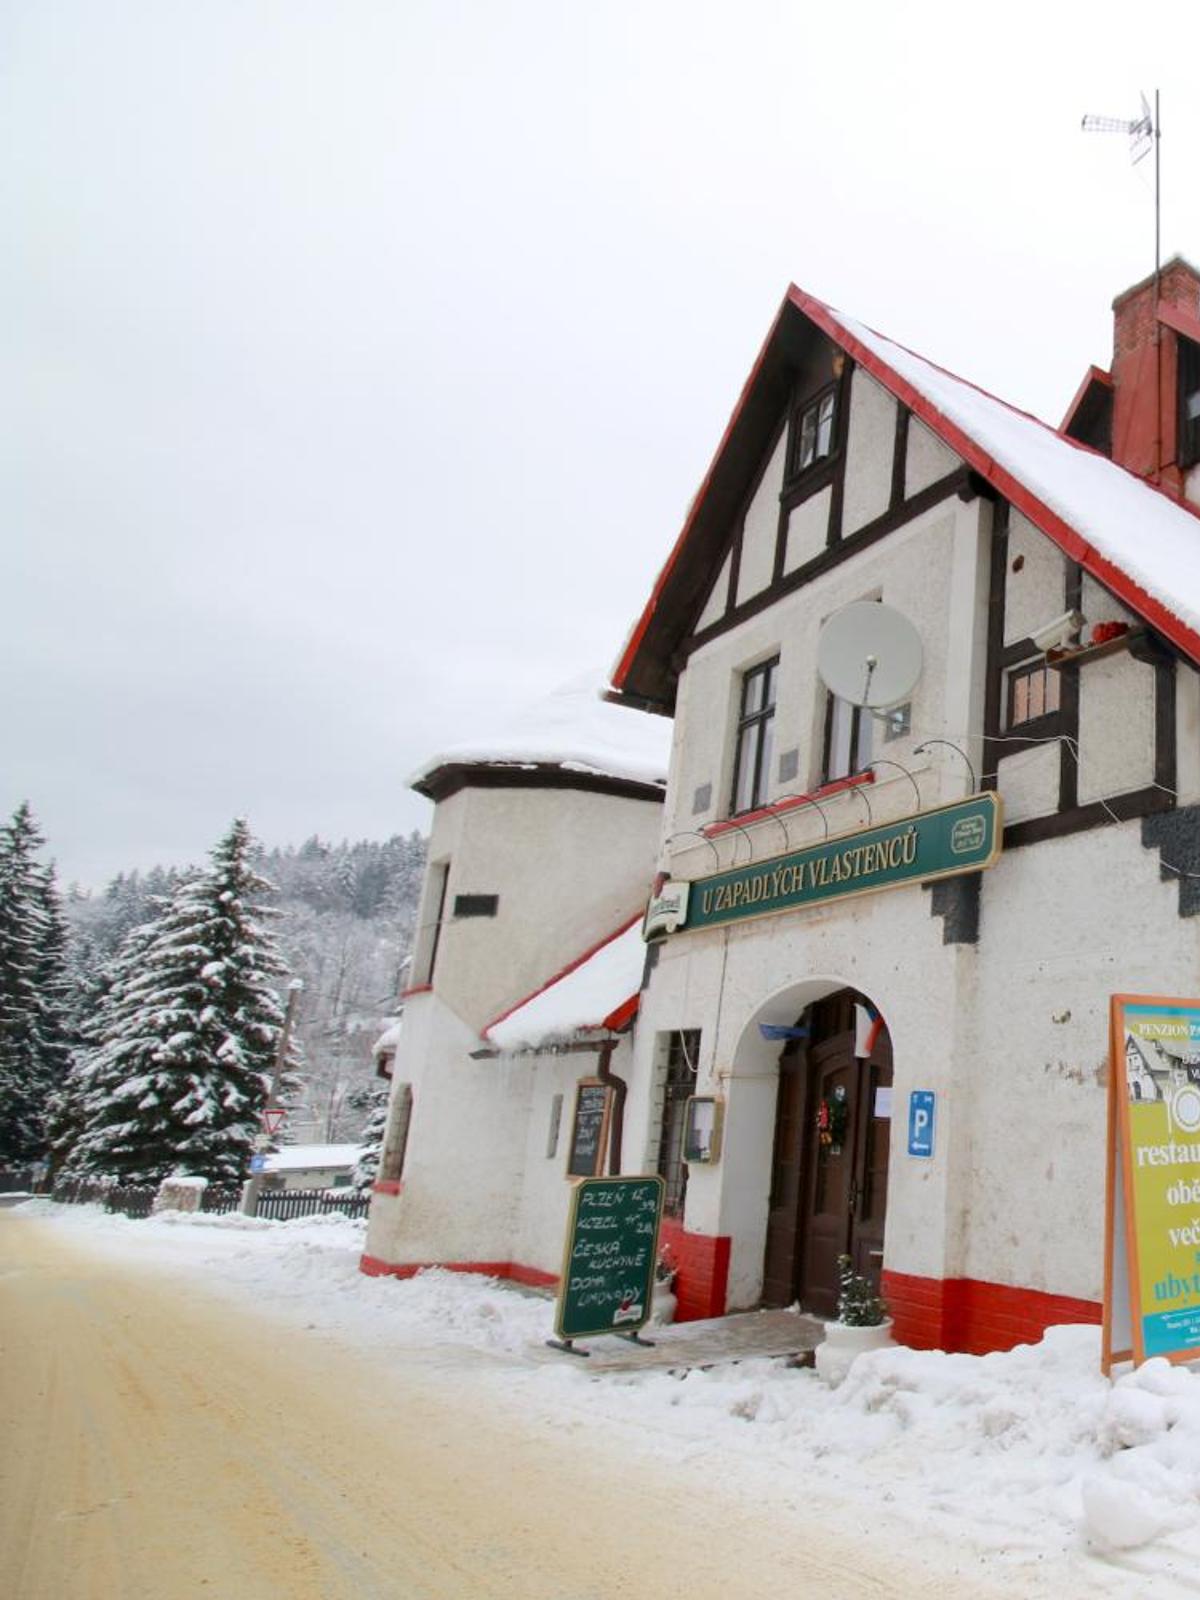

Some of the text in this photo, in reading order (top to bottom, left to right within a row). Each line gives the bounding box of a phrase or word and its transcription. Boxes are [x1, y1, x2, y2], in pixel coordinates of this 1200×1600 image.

[703, 886, 714, 914] U
[715, 864, 804, 911] ZAPADLÝCH
[809, 825, 918, 888] VLASTENCŮ
[1139, 1023, 1188, 1037] PENZION
[915, 1108, 929, 1139] P
[573, 1236, 624, 1257] ČESKÁ
